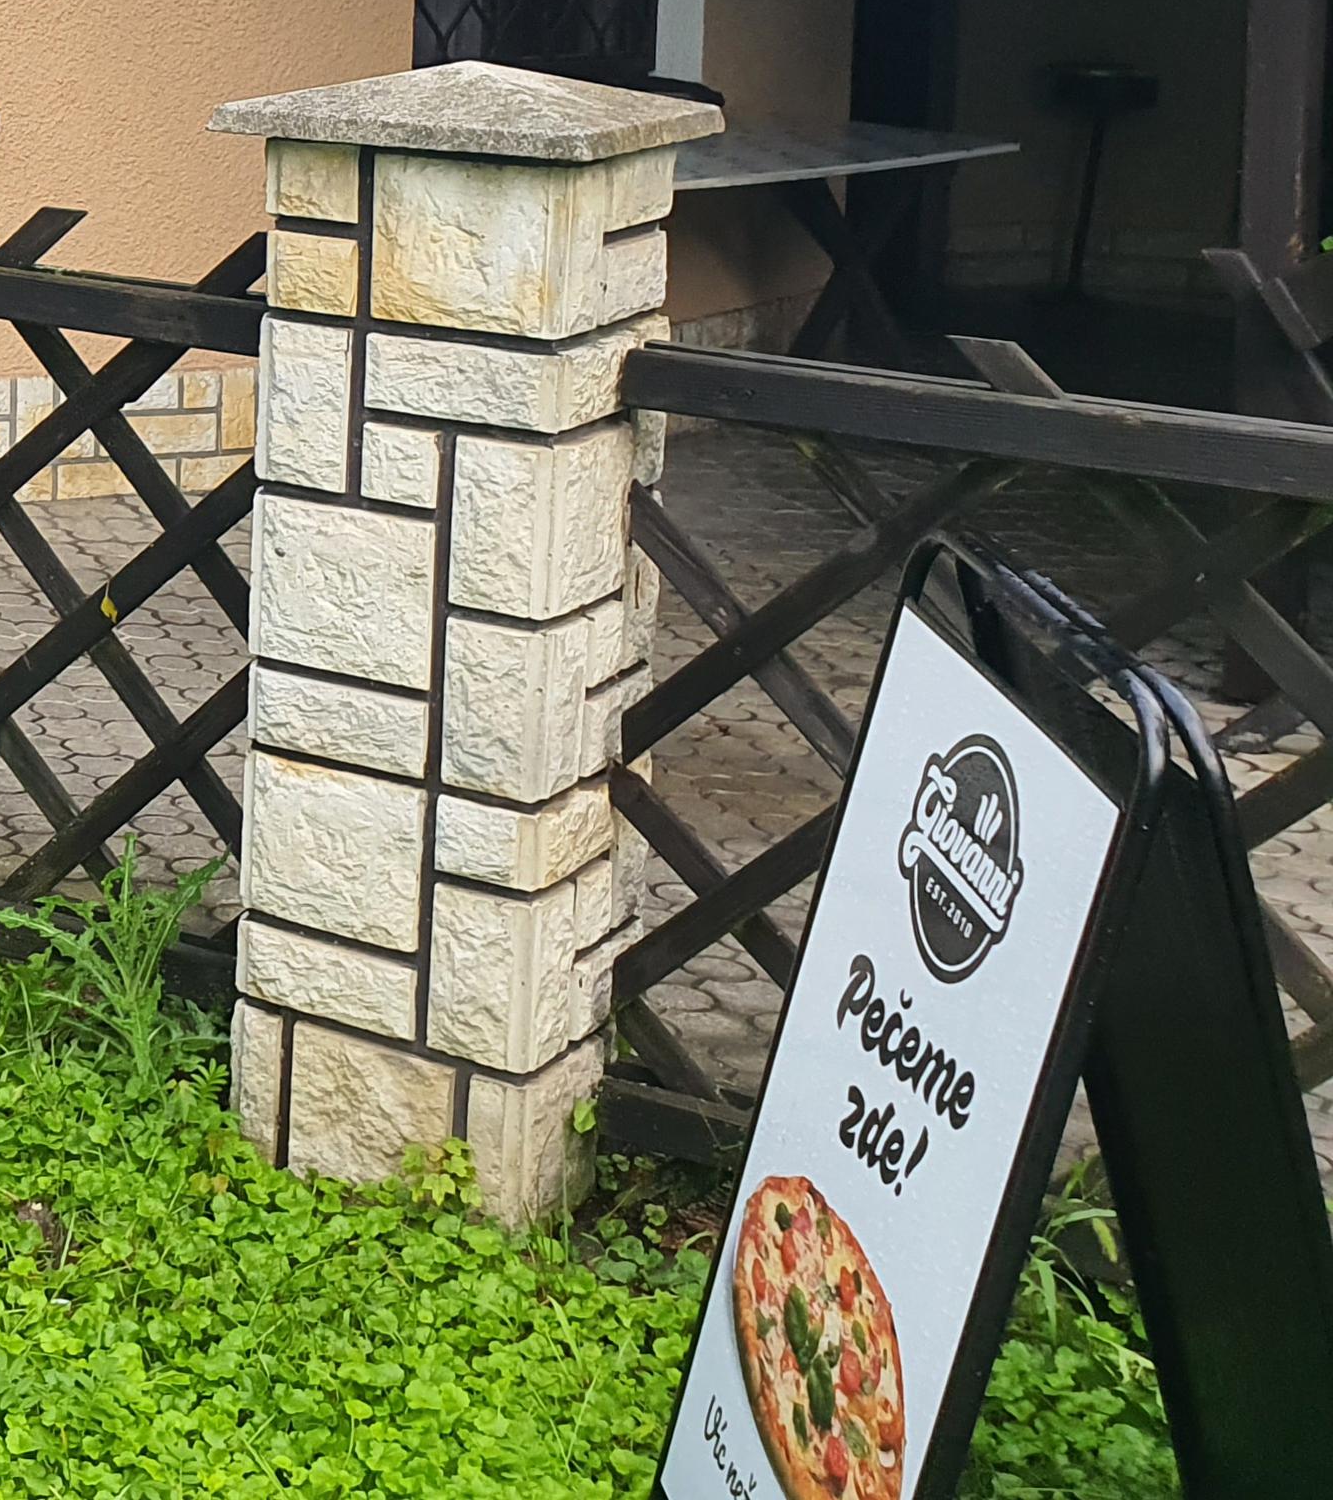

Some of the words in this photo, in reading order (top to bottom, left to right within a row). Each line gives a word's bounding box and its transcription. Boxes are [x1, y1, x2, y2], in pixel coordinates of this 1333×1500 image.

[903, 764, 1021, 932] Giovanni
[836, 953, 976, 1132] Pečeme
[837, 1084, 930, 1198] zde!
